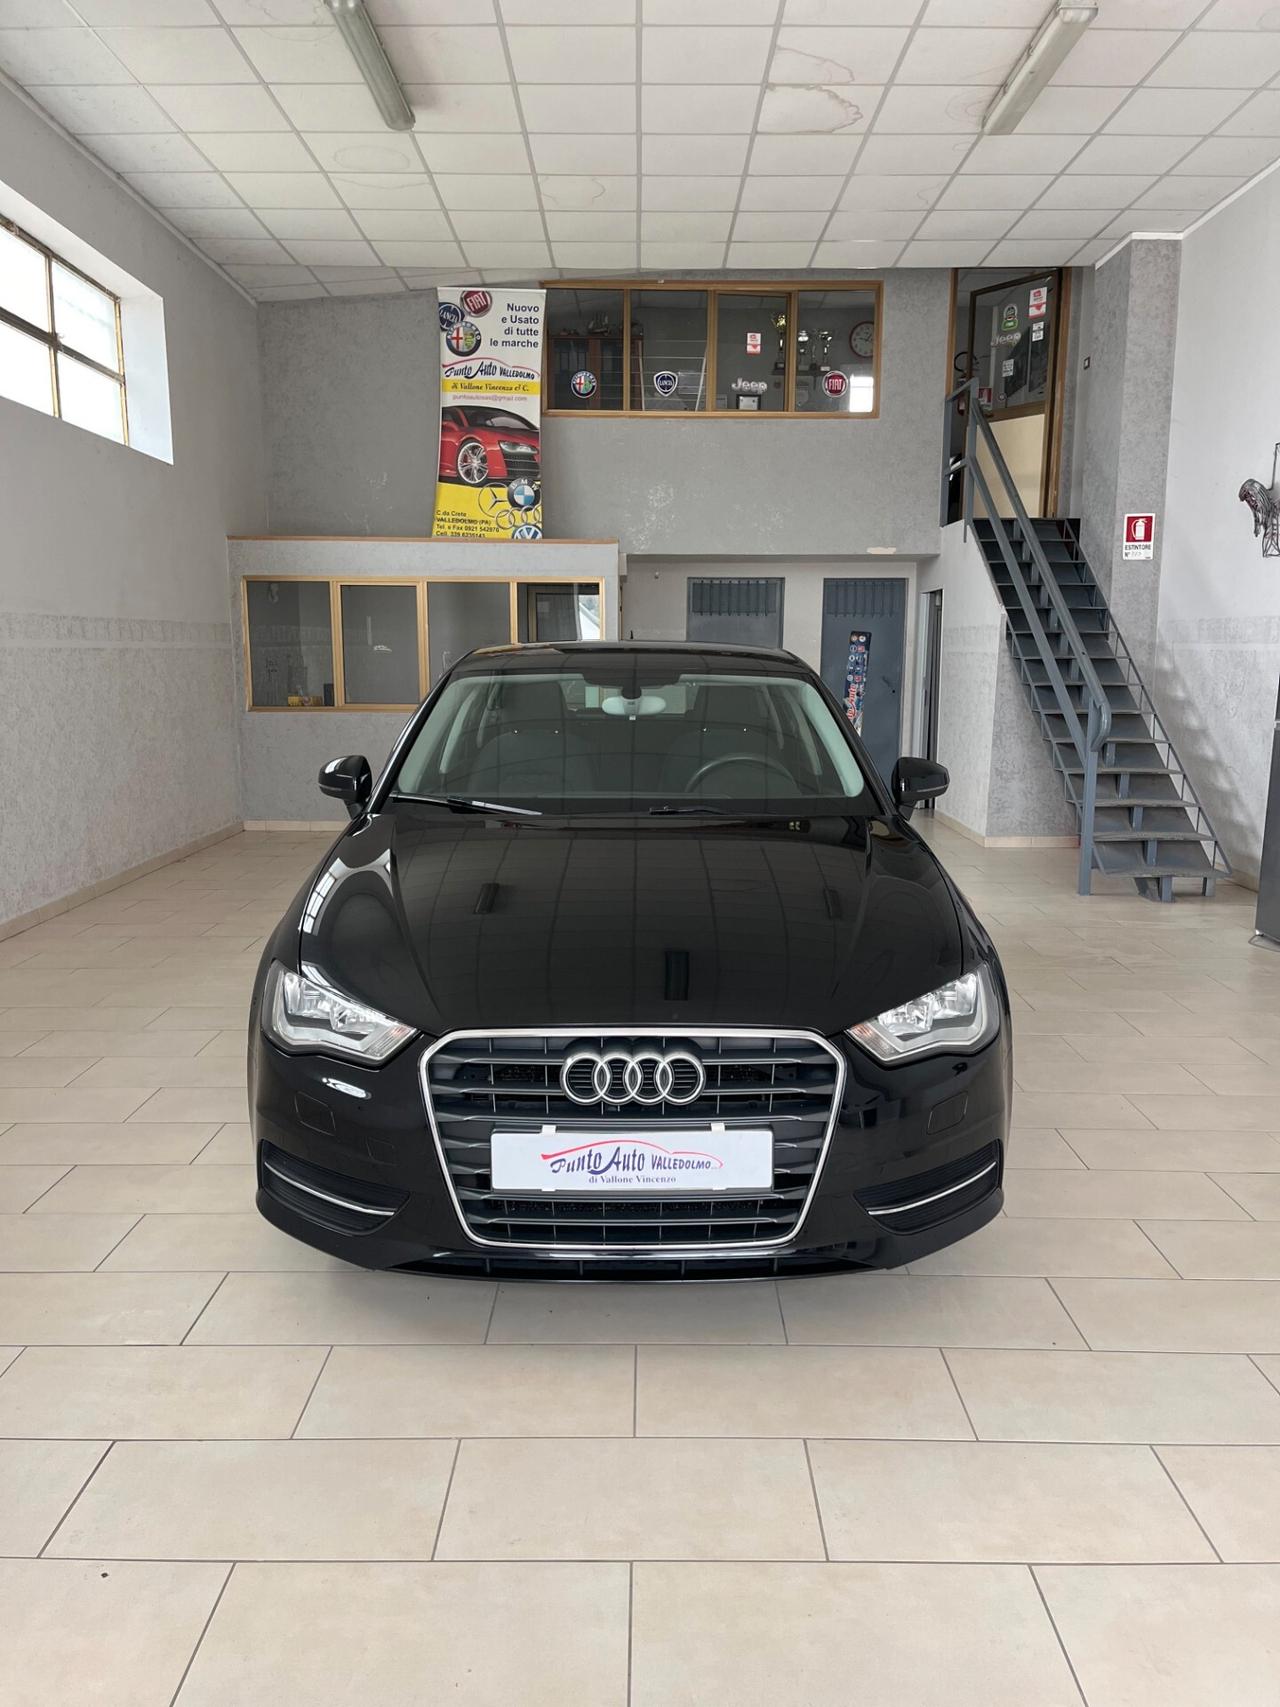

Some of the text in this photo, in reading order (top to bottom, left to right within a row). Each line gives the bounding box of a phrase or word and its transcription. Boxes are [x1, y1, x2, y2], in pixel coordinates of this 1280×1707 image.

[466, 291, 488, 311] FIAT
[506, 303, 540, 313] Nuovo
[510, 315, 540, 325] Usato
[504, 327, 539, 337] di tutte
[490, 338, 539, 348] le marche
[990, 332, 1022, 346] Jeep
[444, 361, 535, 380] Punto Auto VALLEDOLMO
[731, 378, 768, 394] Jeep
[828, 378, 843, 390] FIAT
[549, 1146, 712, 1176] Punto Auto VALLEDOLMO
[588, 1175, 677, 1184] di Vallone Vincenzo
